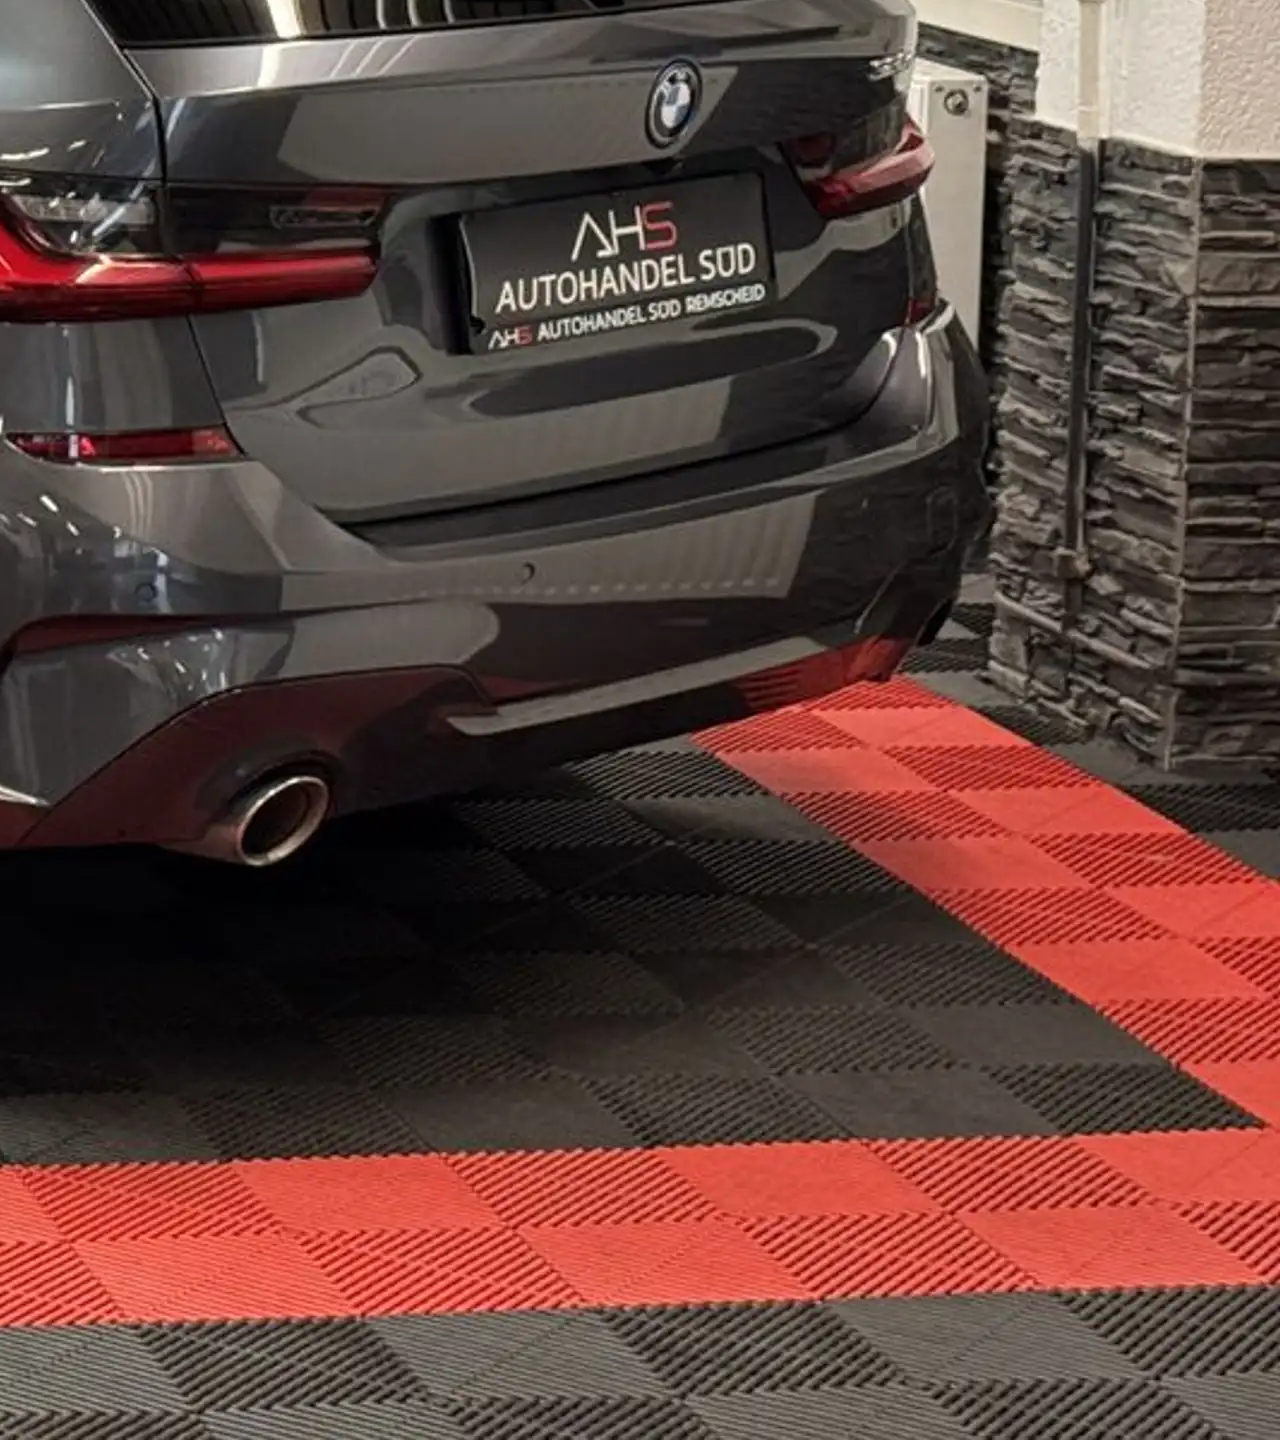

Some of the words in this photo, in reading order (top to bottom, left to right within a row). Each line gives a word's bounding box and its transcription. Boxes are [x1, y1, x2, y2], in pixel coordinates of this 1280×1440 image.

[571, 201, 677, 262] AHS
[495, 255, 695, 314] AUTOHANDEL
[698, 242, 756, 281] SÜD
[488, 325, 533, 350] AHS
[537, 305, 647, 342] AUTOHANDEL
[685, 283, 766, 312] REMSCHEID
